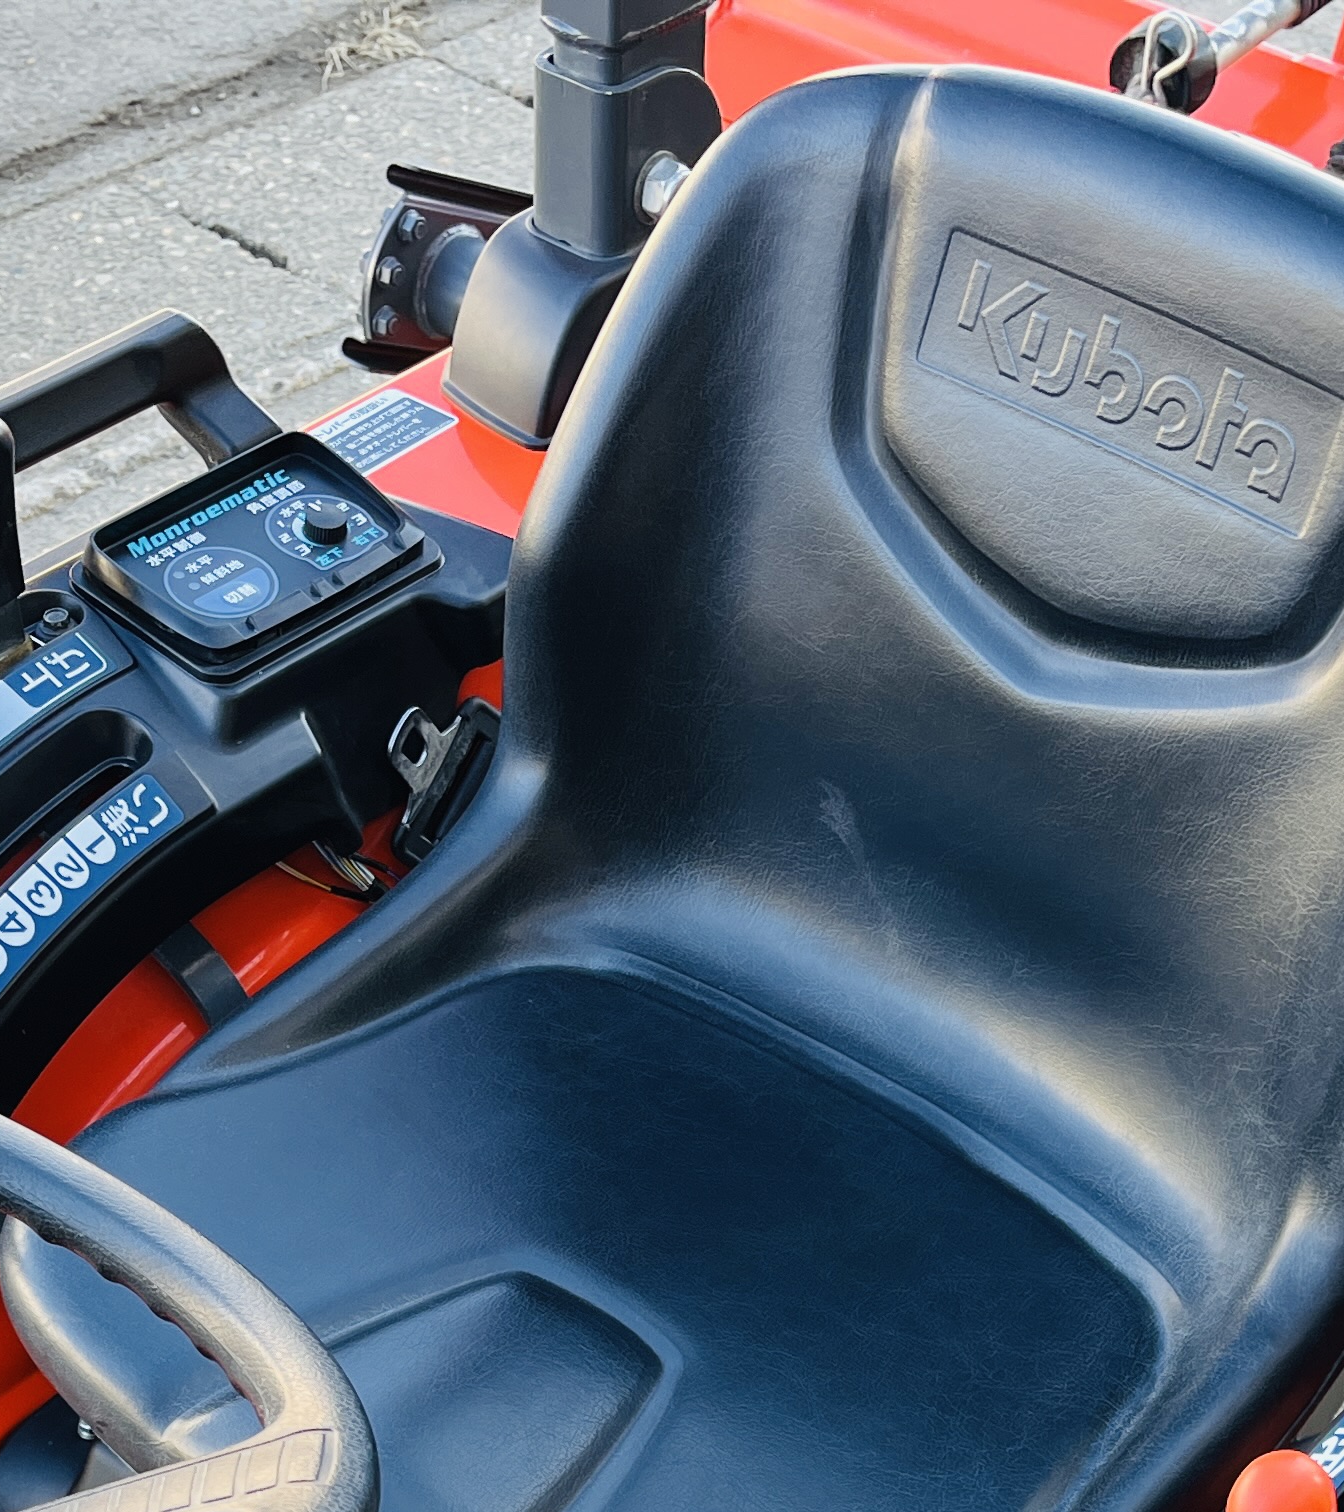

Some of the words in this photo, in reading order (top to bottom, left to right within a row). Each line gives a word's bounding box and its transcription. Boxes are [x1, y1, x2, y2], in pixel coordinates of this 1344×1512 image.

[957, 258, 1297, 504] Kubota
[246, 479, 307, 516] 角度調節
[279, 498, 307, 519] 水平
[336, 500, 350, 514] 2
[126, 466, 290, 559] Monroematic
[353, 513, 368, 527] 3
[145, 530, 207, 568] 水平制御
[279, 532, 293, 545] 2
[294, 543, 310, 558] 3
[351, 527, 381, 548] 右下
[184, 553, 215, 575] 水平
[315, 546, 344, 568] 左下
[200, 557, 245, 587] 傾斜地
[223, 580, 260, 606] 切替
[21, 646, 90, 694] 上げ
[101, 783, 164, 847] 浅い
[86, 834, 106, 854] 1
[54, 853, 84, 881] 2
[26, 880, 55, 908] 3
